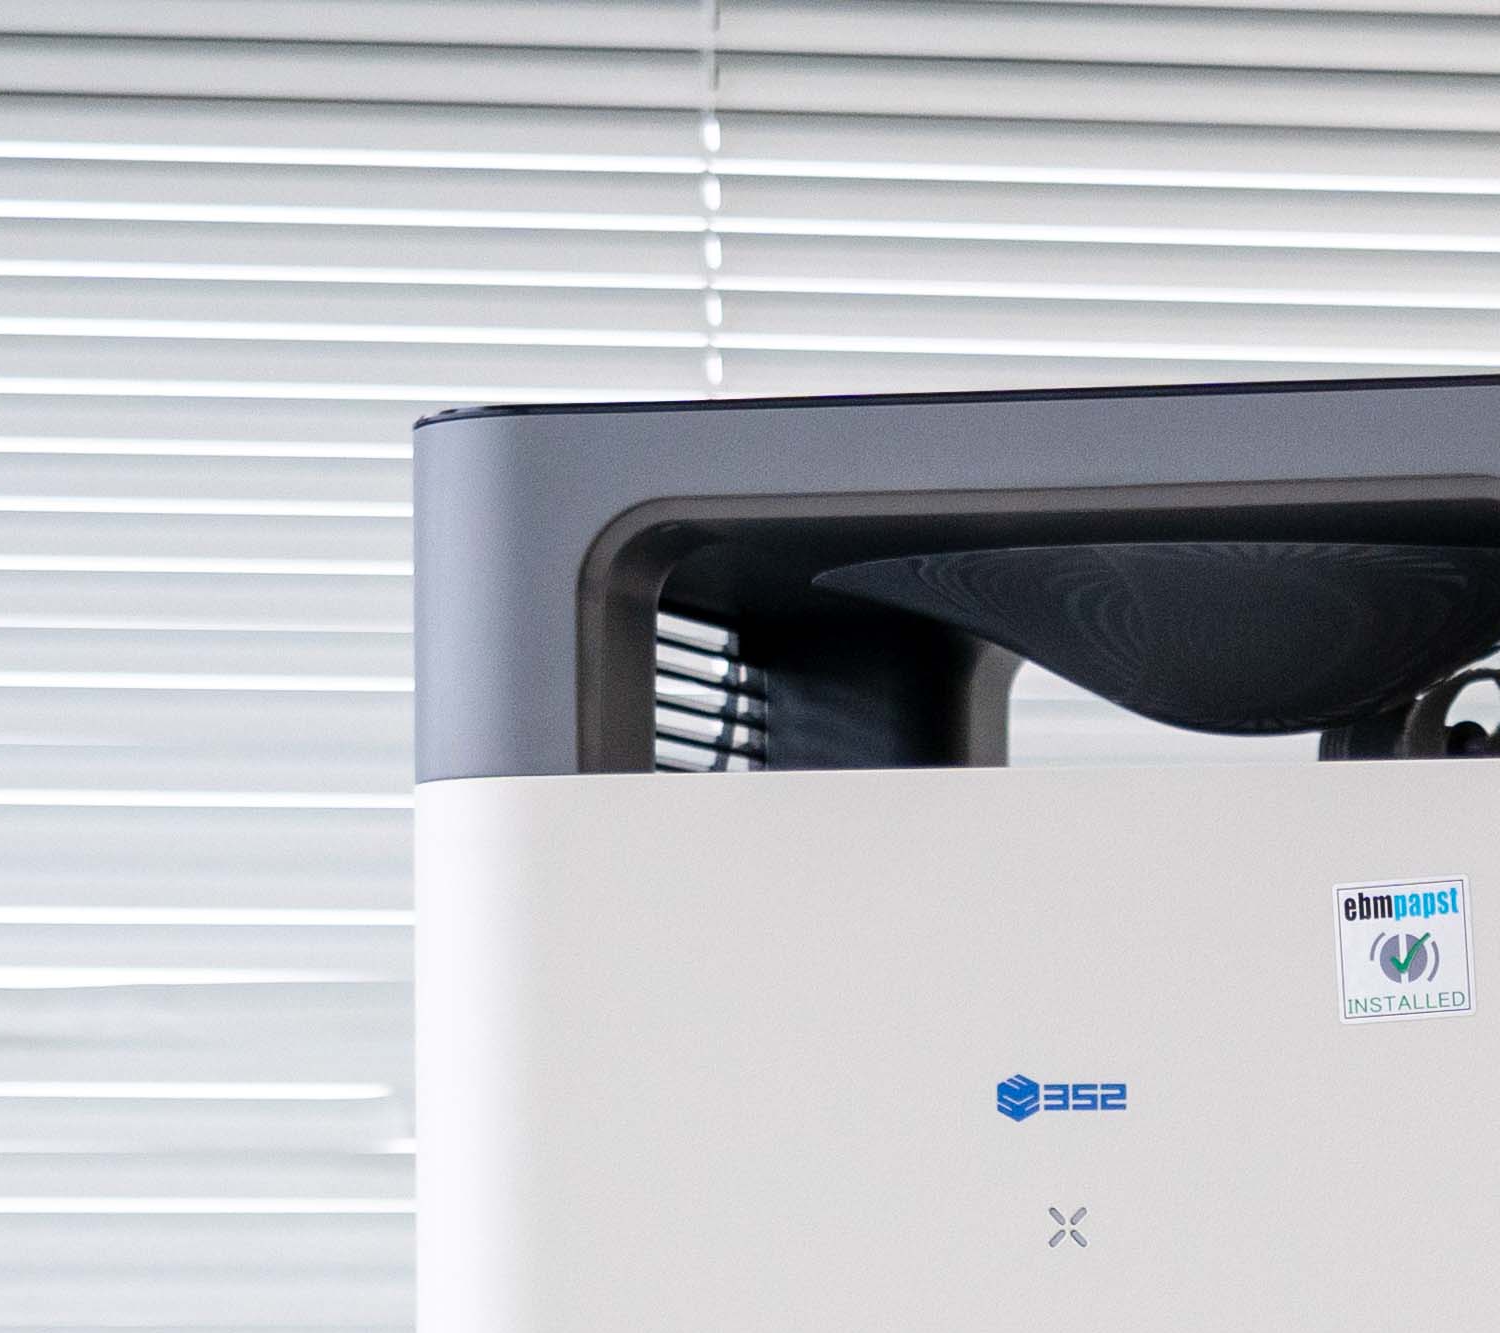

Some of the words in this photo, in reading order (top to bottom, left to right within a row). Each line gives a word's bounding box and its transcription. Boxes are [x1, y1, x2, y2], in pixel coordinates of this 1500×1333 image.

[1343, 887, 1460, 921] ebmpapst
[1347, 991, 1466, 1014] INSTALLED
[1043, 1084, 1127, 1111] 352
